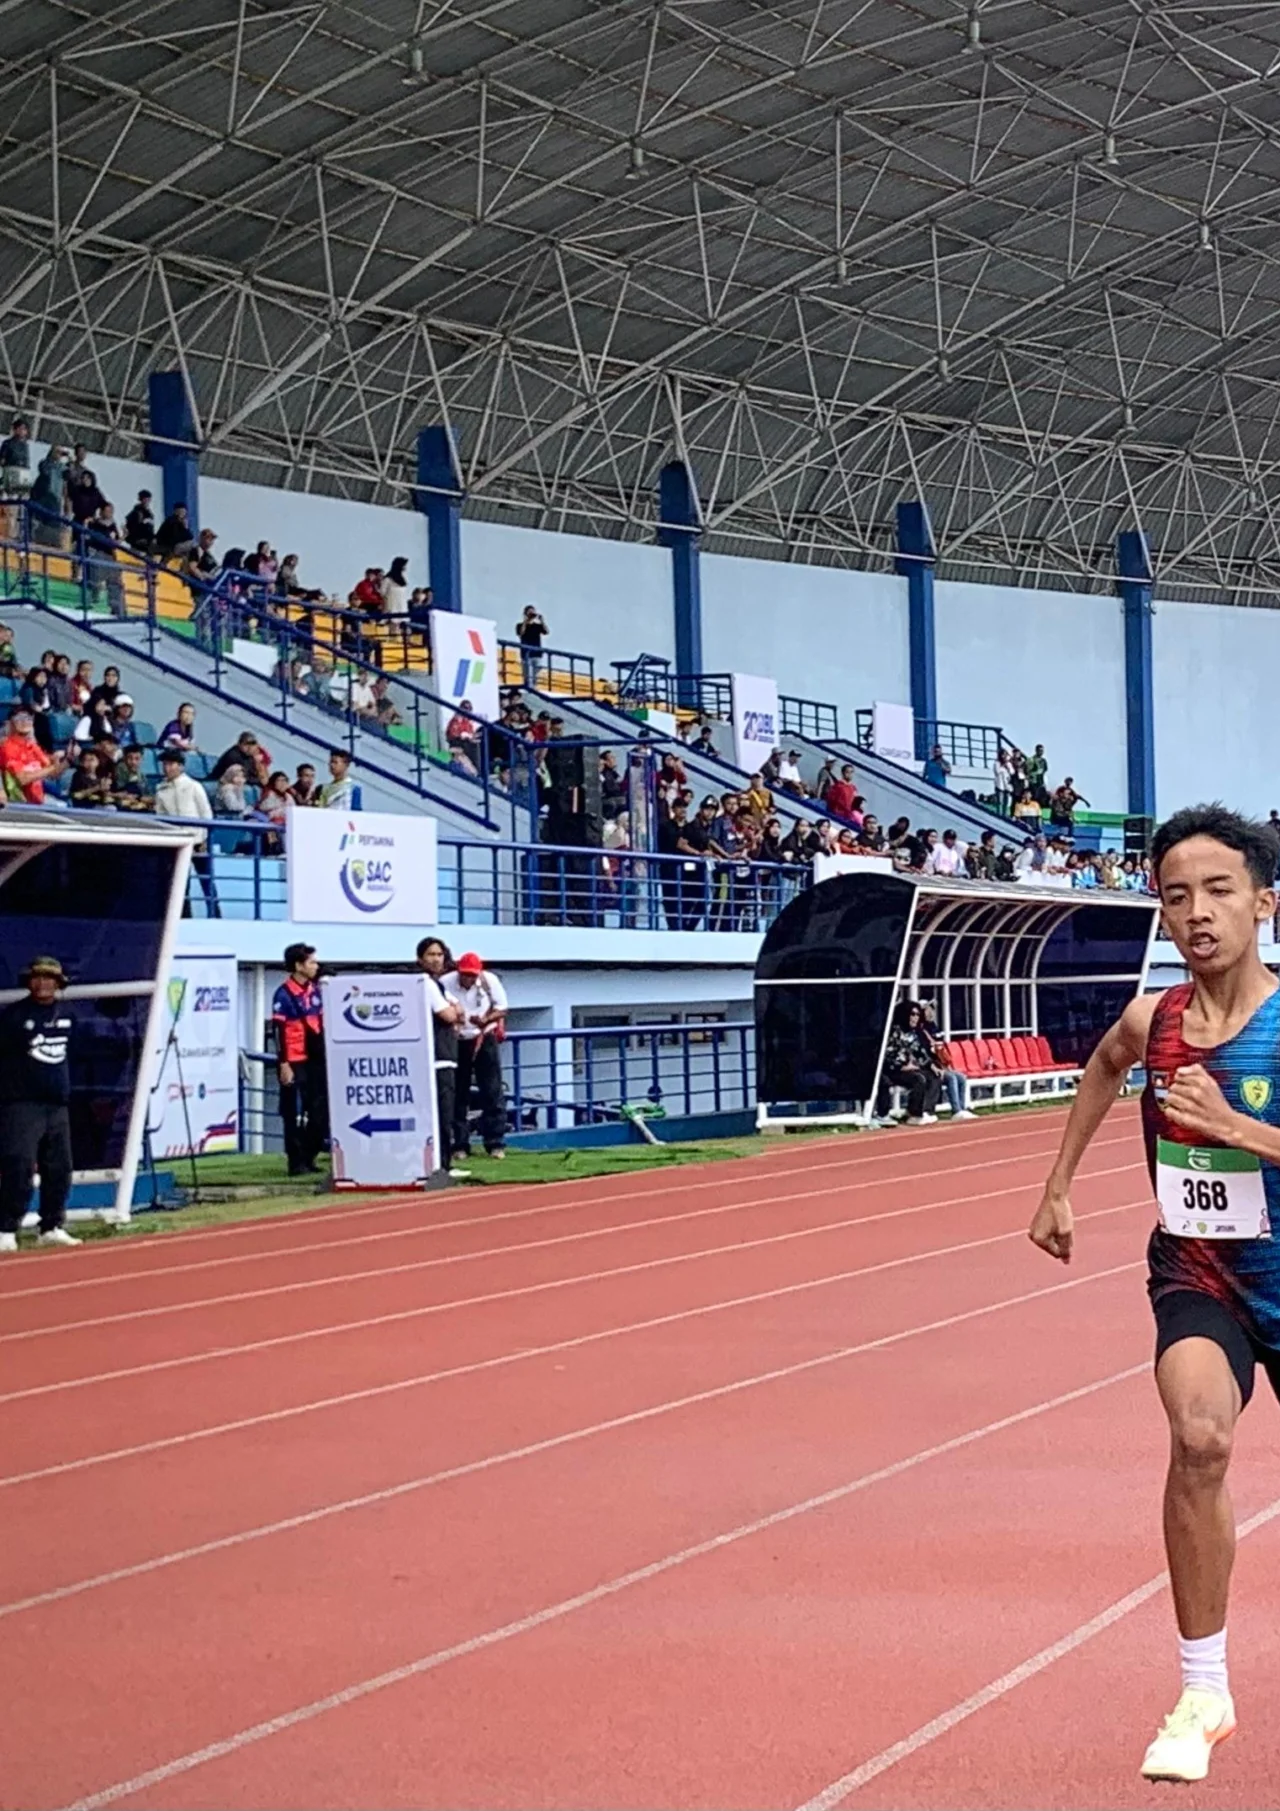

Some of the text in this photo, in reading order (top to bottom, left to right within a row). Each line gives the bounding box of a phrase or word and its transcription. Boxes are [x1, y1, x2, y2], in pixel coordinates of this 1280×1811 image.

[366, 860, 392, 883] SAC
[373, 1003, 401, 1017] SAC
[348, 1056, 409, 1078] KELUAR
[346, 1083, 414, 1106] PESERTA
[1182, 1178, 1228, 1212] 368
